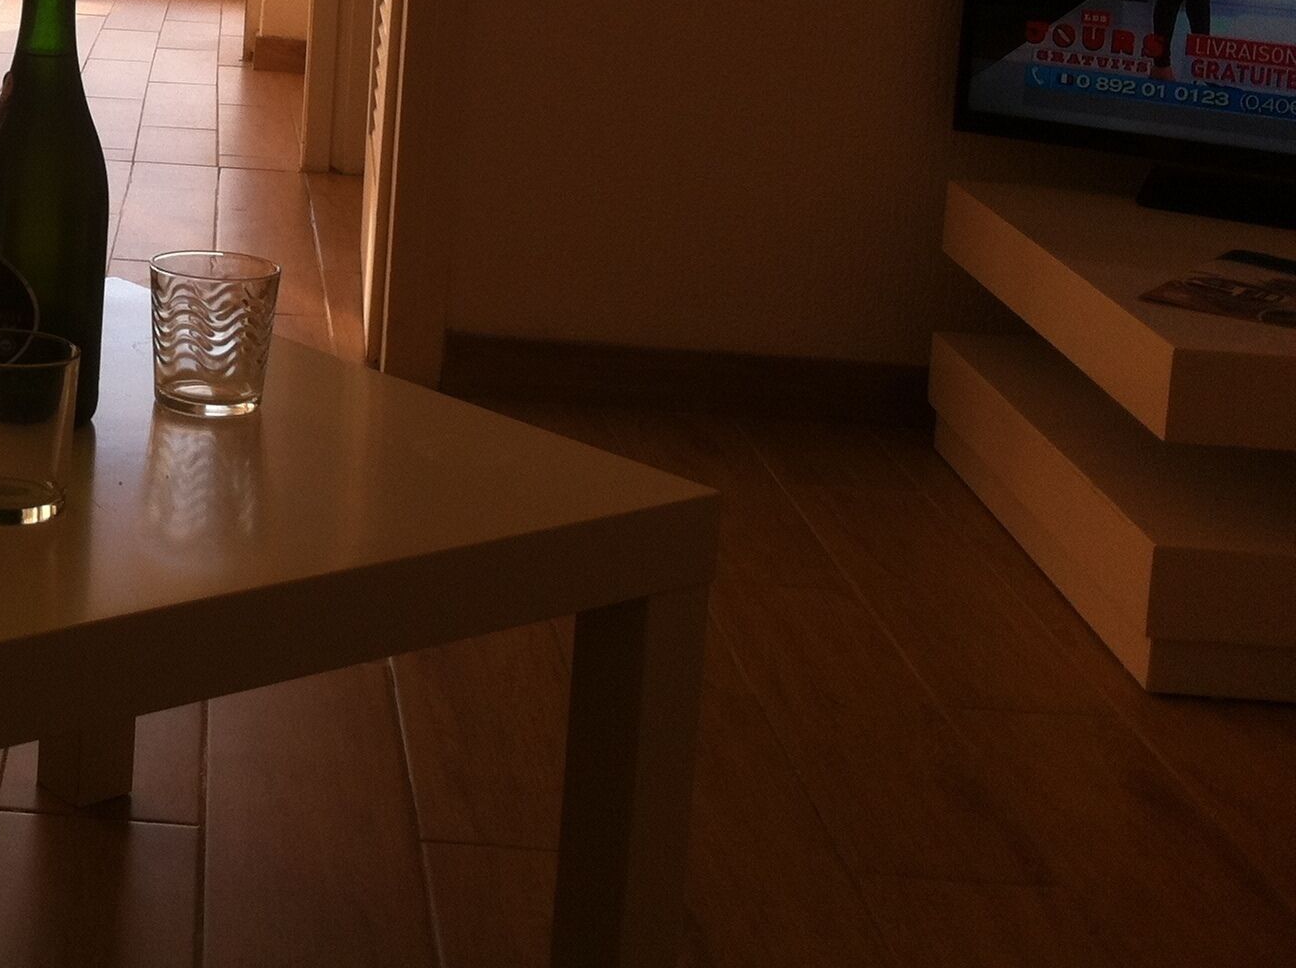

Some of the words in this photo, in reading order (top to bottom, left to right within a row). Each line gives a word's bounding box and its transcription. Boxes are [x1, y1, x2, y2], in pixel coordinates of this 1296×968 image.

[1024, 19, 1168, 59] JOURS
[1196, 37, 1296, 66] LIVRAISON
[1036, 50, 1148, 73] GRATUITS
[1076, 74, 1090, 89] 0
[1095, 76, 1136, 95] 892
[1141, 82, 1166, 99] 01
[1174, 87, 1230, 107] 0123
